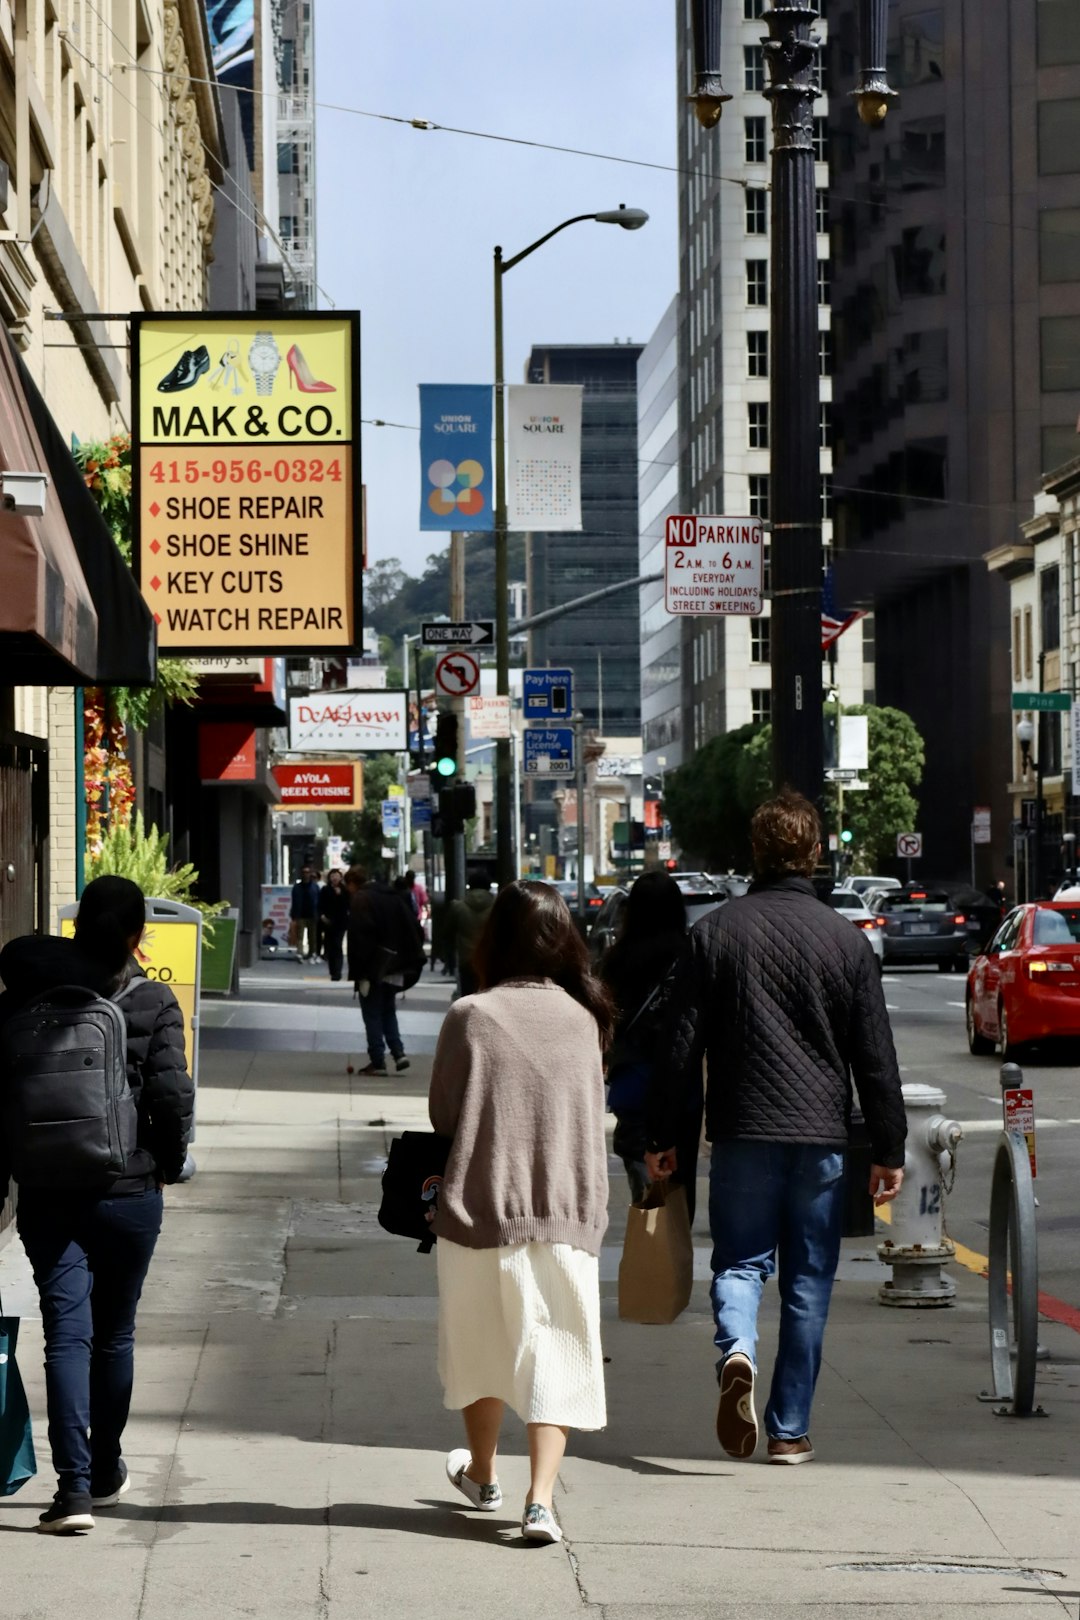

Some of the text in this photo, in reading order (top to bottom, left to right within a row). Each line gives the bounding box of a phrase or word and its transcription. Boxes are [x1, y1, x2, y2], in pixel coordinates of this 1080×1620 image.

[434, 423, 478, 434] SQUARE
[522, 423, 565, 434] SQUARE
[149, 459, 342, 484] 415-956-0324
[166, 496, 324, 519] SHOE REPAIR
[668, 519, 760, 544] NO PARKING
[166, 533, 309, 557] SHOE SHINE
[168, 570, 283, 594] KEY CUTS
[693, 574, 735, 583] EVERYDAY
[670, 586, 758, 597] INCLUDING HOLIDAYS
[672, 601, 755, 611] STREET SWEEPING
[167, 607, 343, 631] WATCH REPAIR
[427, 628, 472, 640] ONE WAY
[526, 674, 569, 686] Pay here
[1030, 696, 1054, 706] Pine
[526, 732, 558, 742] Pay by
[526, 742, 562, 750] License
[294, 773, 331, 784] AYOLA
[281, 786, 350, 797] REEK CUISINE
[146, 966, 177, 982] CO.
[920, 1184, 940, 1215] 12
